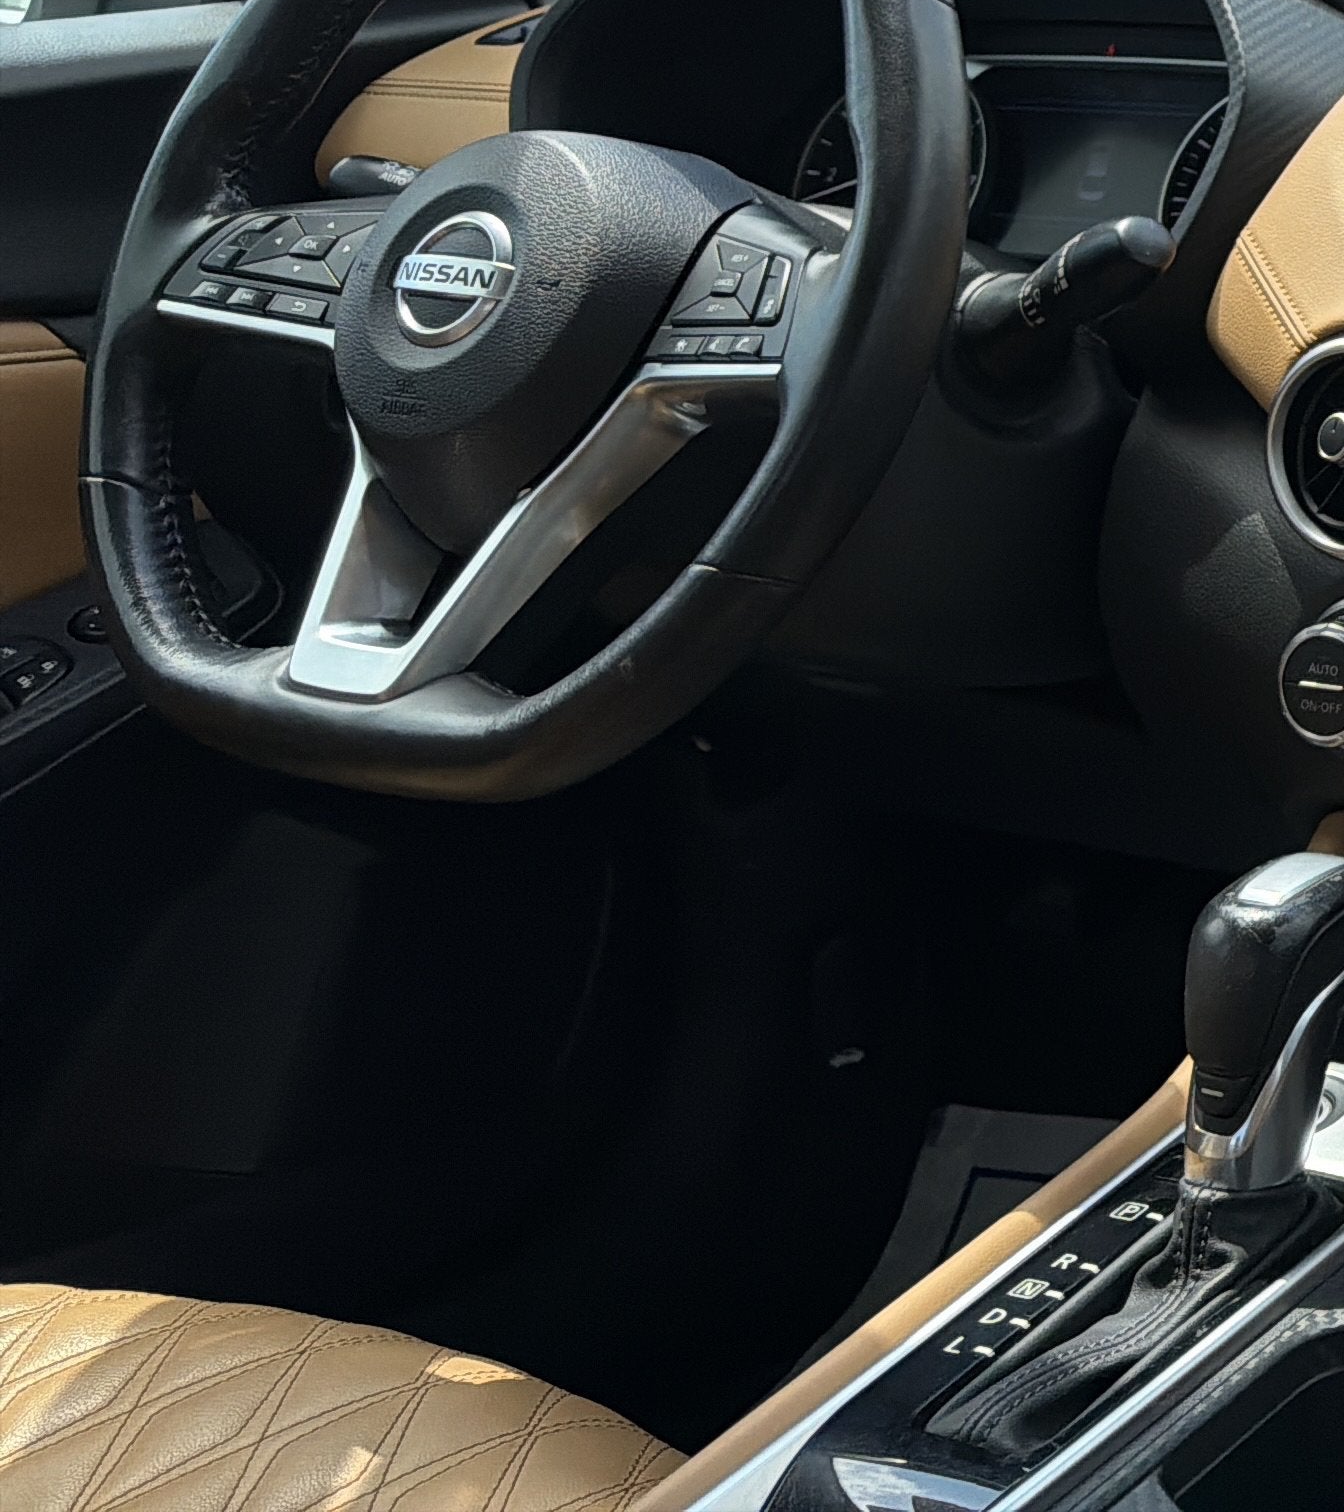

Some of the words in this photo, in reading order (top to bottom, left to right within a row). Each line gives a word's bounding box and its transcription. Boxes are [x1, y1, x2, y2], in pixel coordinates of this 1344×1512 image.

[304, 240, 319, 251] OK
[400, 261, 496, 289] NISSAN
[1308, 662, 1339, 676] AUTO
[1051, 1253, 1078, 1270] R
[978, 1308, 1007, 1323] D
[943, 1336, 965, 1354] L
